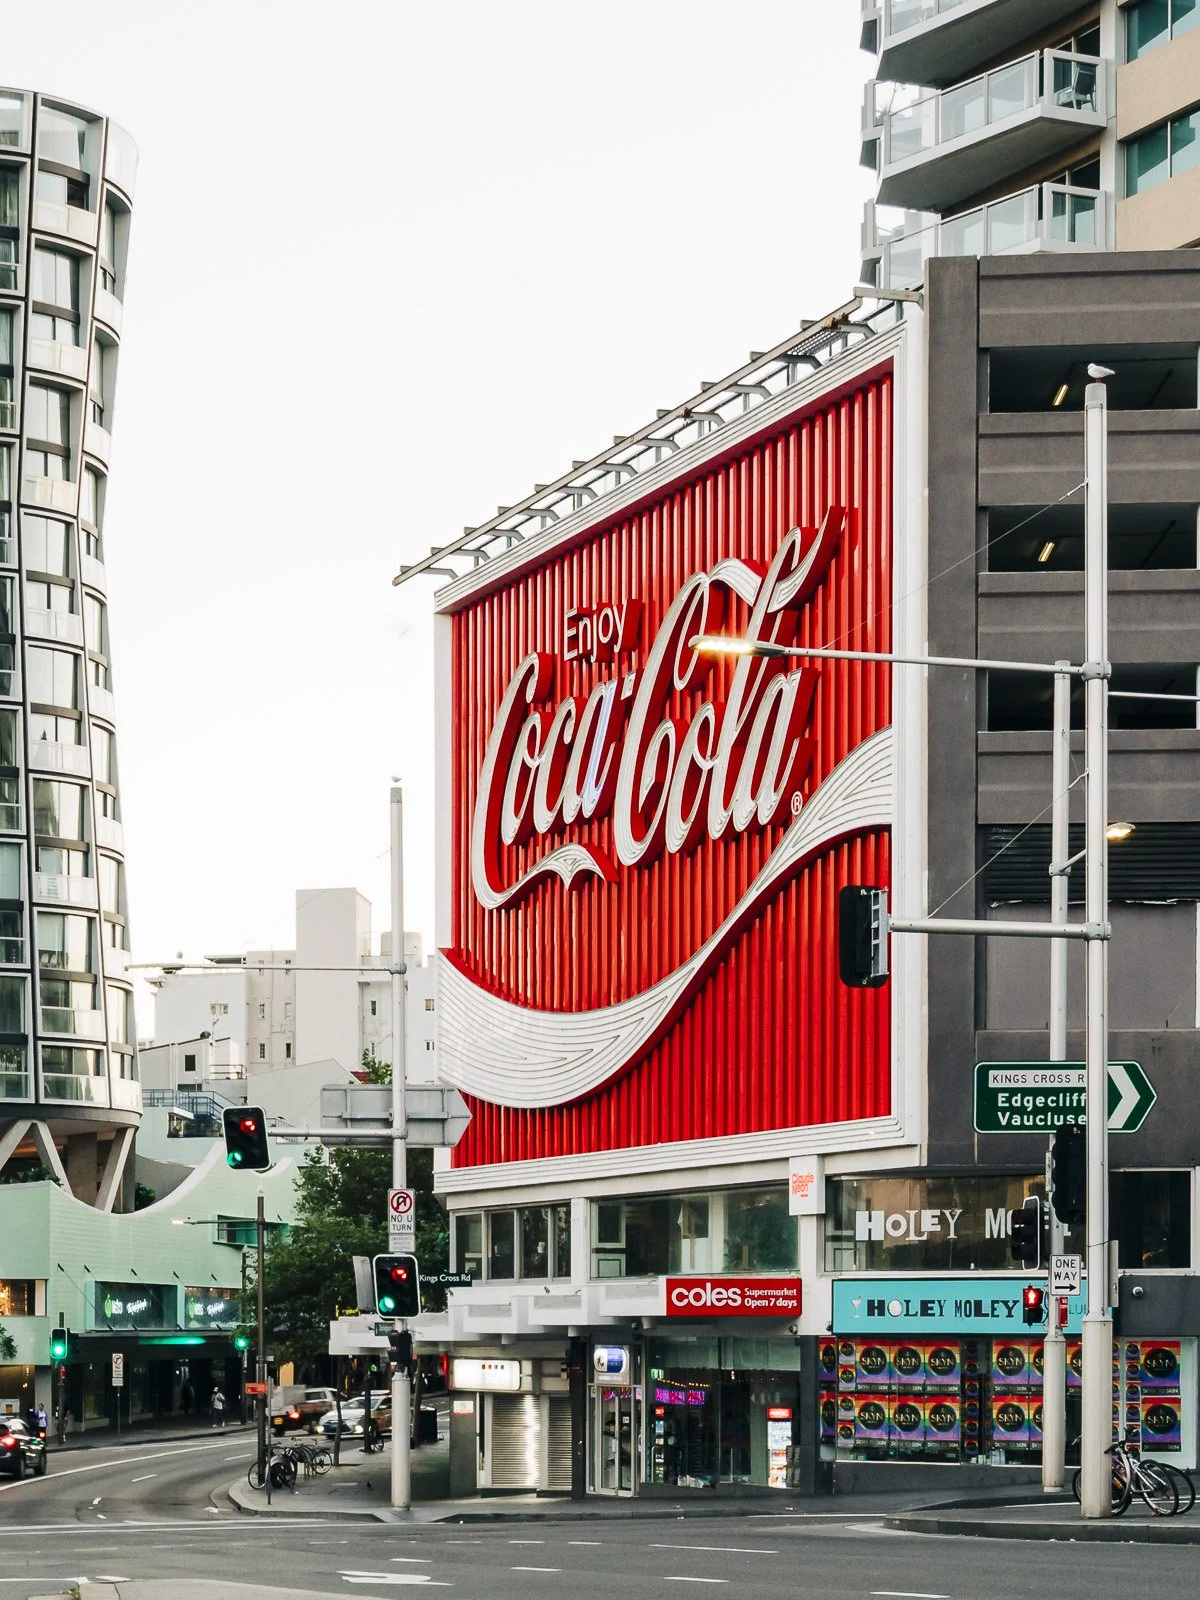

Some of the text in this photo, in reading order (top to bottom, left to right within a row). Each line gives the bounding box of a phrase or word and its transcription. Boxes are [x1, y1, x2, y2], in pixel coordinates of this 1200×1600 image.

[563, 599, 628, 663] Enjoy
[472, 506, 834, 910] Coca-Cola
[992, 1074, 1085, 1084] KINGS CROSS R
[998, 1092, 1087, 1112] Edgecliff
[998, 1111, 1087, 1126] Vaucluse
[792, 1173, 814, 1184] Claude
[792, 1183, 809, 1195] Neon
[390, 1214, 413, 1222] NO U
[855, 1209, 963, 1241] HOLEY
[1055, 1258, 1076, 1269] ONE
[419, 1274, 438, 1283] Kings
[439, 1274, 459, 1282] Cross
[1053, 1271, 1078, 1281] WAY
[671, 1282, 797, 1307] coles Supermarket
[744, 1298, 798, 1308] Open 7 days
[866, 1299, 947, 1318] HOLEY
[954, 1299, 1020, 1318] MOLEY
